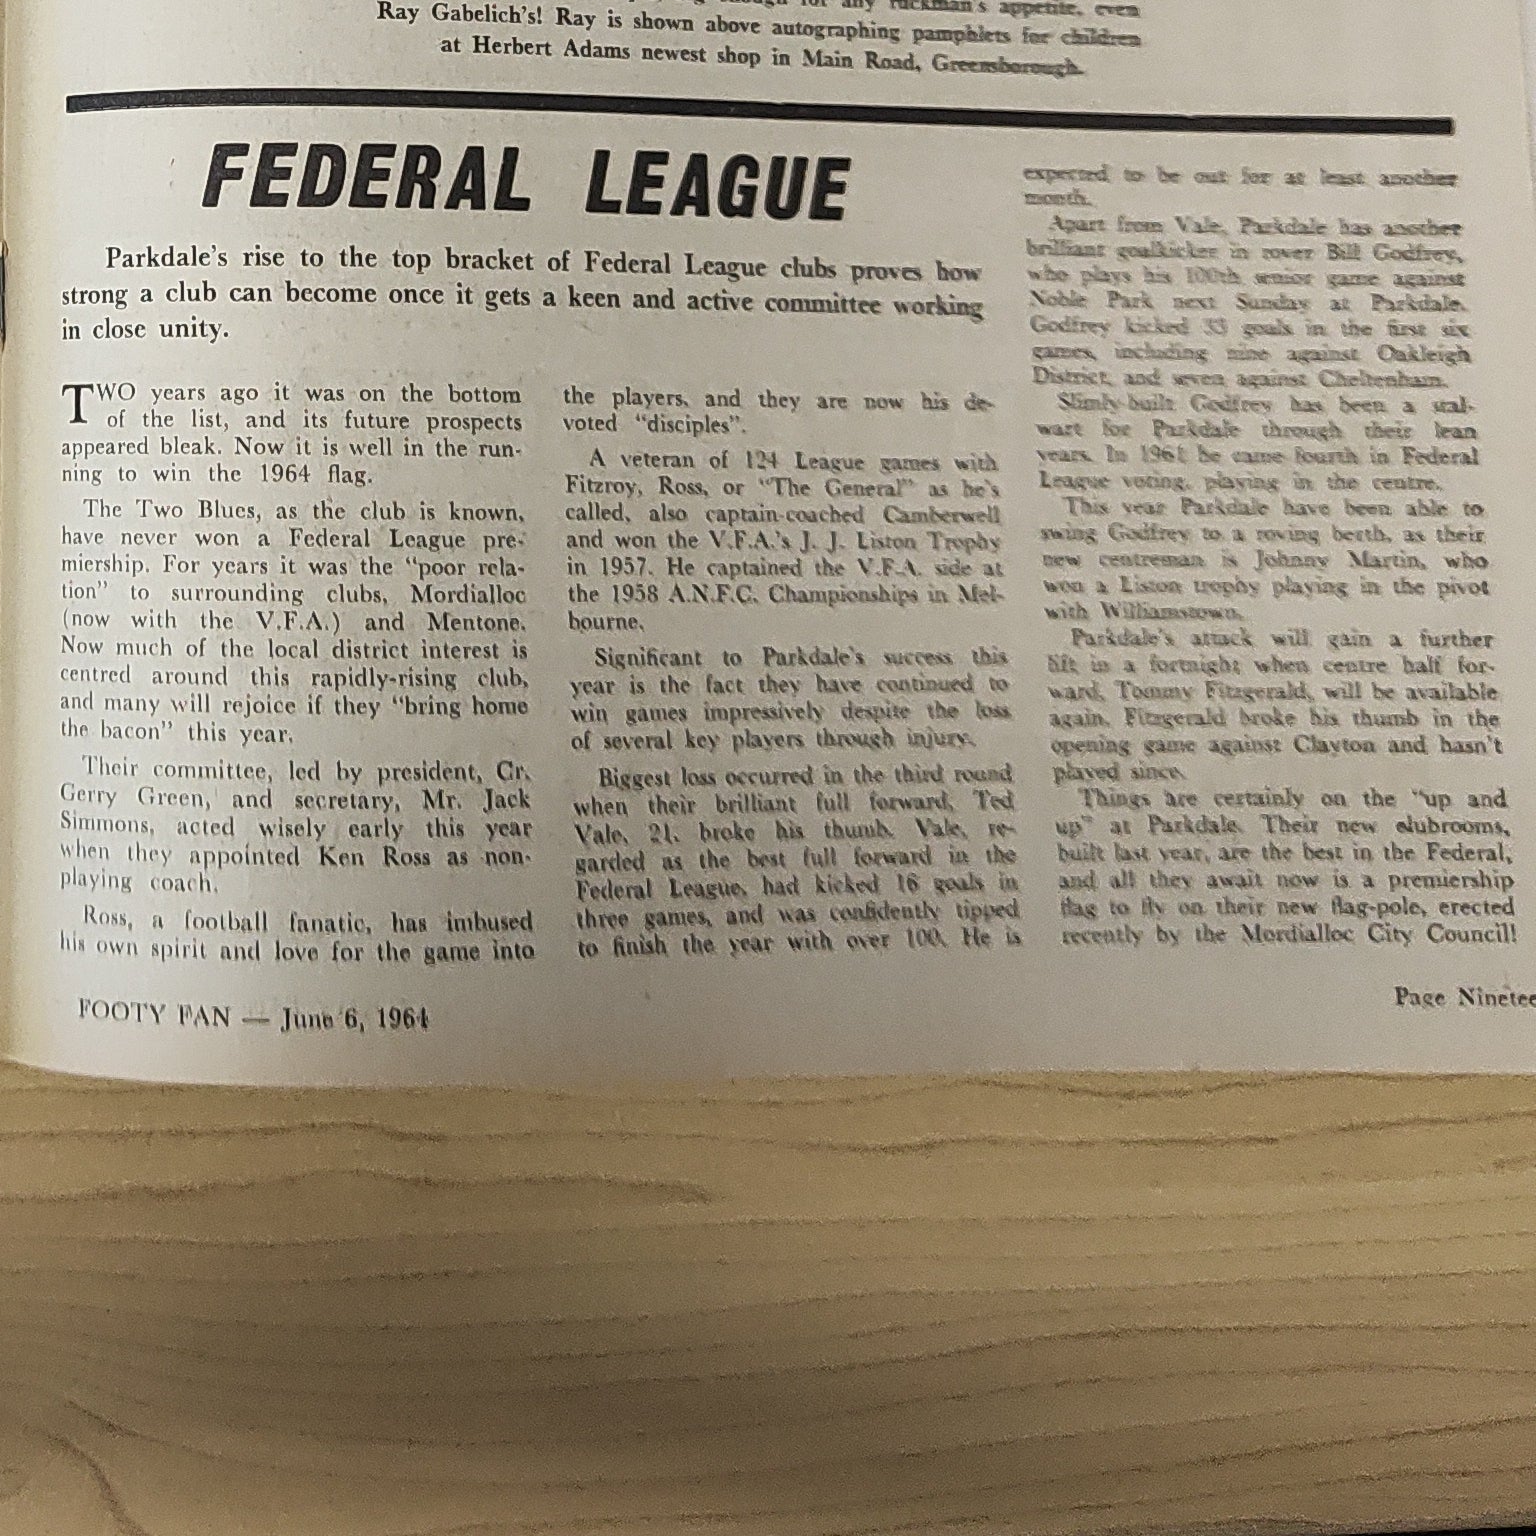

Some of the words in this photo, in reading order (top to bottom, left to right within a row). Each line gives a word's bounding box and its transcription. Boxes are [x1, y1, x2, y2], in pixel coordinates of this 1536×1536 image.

[377, 1, 419, 25] Ray
[432, 3, 542, 24] Gabelich's!
[556, 6, 596, 31] Ray
[608, 9, 622, 28] is
[634, 11, 693, 31] shown
[706, 14, 760, 34] above
[772, 21, 900, 43] autographing
[1022, 26, 1051, 44] for
[441, 37, 461, 53] at
[472, 35, 552, 57] Herbert
[564, 39, 630, 59] Adams
[642, 47, 706, 62] newest
[718, 45, 760, 69] shop
[772, 47, 790, 66] in
[803, 49, 853, 68] Main
[865, 50, 921, 72] Road,
[202, 143, 530, 210] FEDERAL
[585, 151, 851, 220] LEAGUE
[106, 245, 227, 269] Parkdale's
[243, 244, 284, 267] rise
[301, 250, 323, 267] to
[340, 245, 377, 268] the
[392, 250, 431, 275] top
[445, 247, 534, 270] bracket
[548, 250, 570, 272] of
[584, 250, 670, 274] Federal
[685, 253, 766, 282] League
[781, 256, 836, 278] clubs
[851, 265, 922, 285] proves
[936, 260, 981, 281] how
[63, 288, 128, 309] strong
[141, 289, 153, 303] a
[166, 280, 216, 302] club
[230, 287, 272, 302] can
[286, 282, 376, 303] become
[389, 288, 443, 305] once
[457, 284, 473, 305] it
[486, 288, 530, 312] gets
[543, 291, 556, 306] a
[568, 286, 620, 308] keen
[633, 288, 675, 310] and
[687, 289, 753, 311] active
[765, 293, 881, 314] committee
[894, 295, 984, 322] working
[63, 318, 80, 340] in
[93, 317, 145, 339] close
[159, 315, 228, 343] unity.
[151, 388, 205, 405] years
[221, 388, 258, 405] ago
[275, 381, 289, 401] it
[304, 388, 344, 402] was
[360, 389, 385, 402] on
[402, 382, 433, 402] the
[448, 383, 521, 403] bottom
[108, 409, 125, 428] of
[143, 409, 173, 428] the
[192, 408, 228, 432] list,
[246, 409, 285, 428] and
[304, 408, 327, 429] its
[345, 410, 409, 430] future
[426, 415, 522, 435] prospects
[563, 413, 617, 432] voted
[62, 436, 149, 460] appeared
[161, 435, 221, 455] bleak.
[235, 436, 284, 455] Now
[296, 436, 311, 456] it
[323, 436, 338, 457] is
[349, 437, 391, 456] well
[404, 437, 423, 457] in
[436, 437, 467, 457] the
[479, 444, 520, 457] run-
[63, 463, 102, 486] ning
[119, 467, 136, 481] to
[153, 463, 191, 481] win
[209, 463, 241, 482] the
[262, 464, 310, 483] 1964
[328, 464, 372, 487] flag.
[568, 583, 599, 603] the
[613, 583, 658, 604] 1958
[669, 583, 758, 605] A.N.F.C.
[768, 583, 918, 608] Championships
[928, 584, 949, 603] in
[63, 607, 110, 630] (now
[131, 608, 176, 629] with
[201, 609, 233, 630] the
[256, 610, 339, 635] V.F.A.)
[365, 611, 404, 632] and
[62, 717, 88, 737] the
[102, 720, 172, 740] bacon"
[189, 721, 226, 742] this
[1395, 986, 1445, 1008] Page
[80, 998, 166, 1024] FOOTY
[178, 1004, 229, 1028] FAN
[281, 1007, 333, 1032] June
[340, 1008, 364, 1033] 6,
[378, 1007, 428, 1030] 1964
